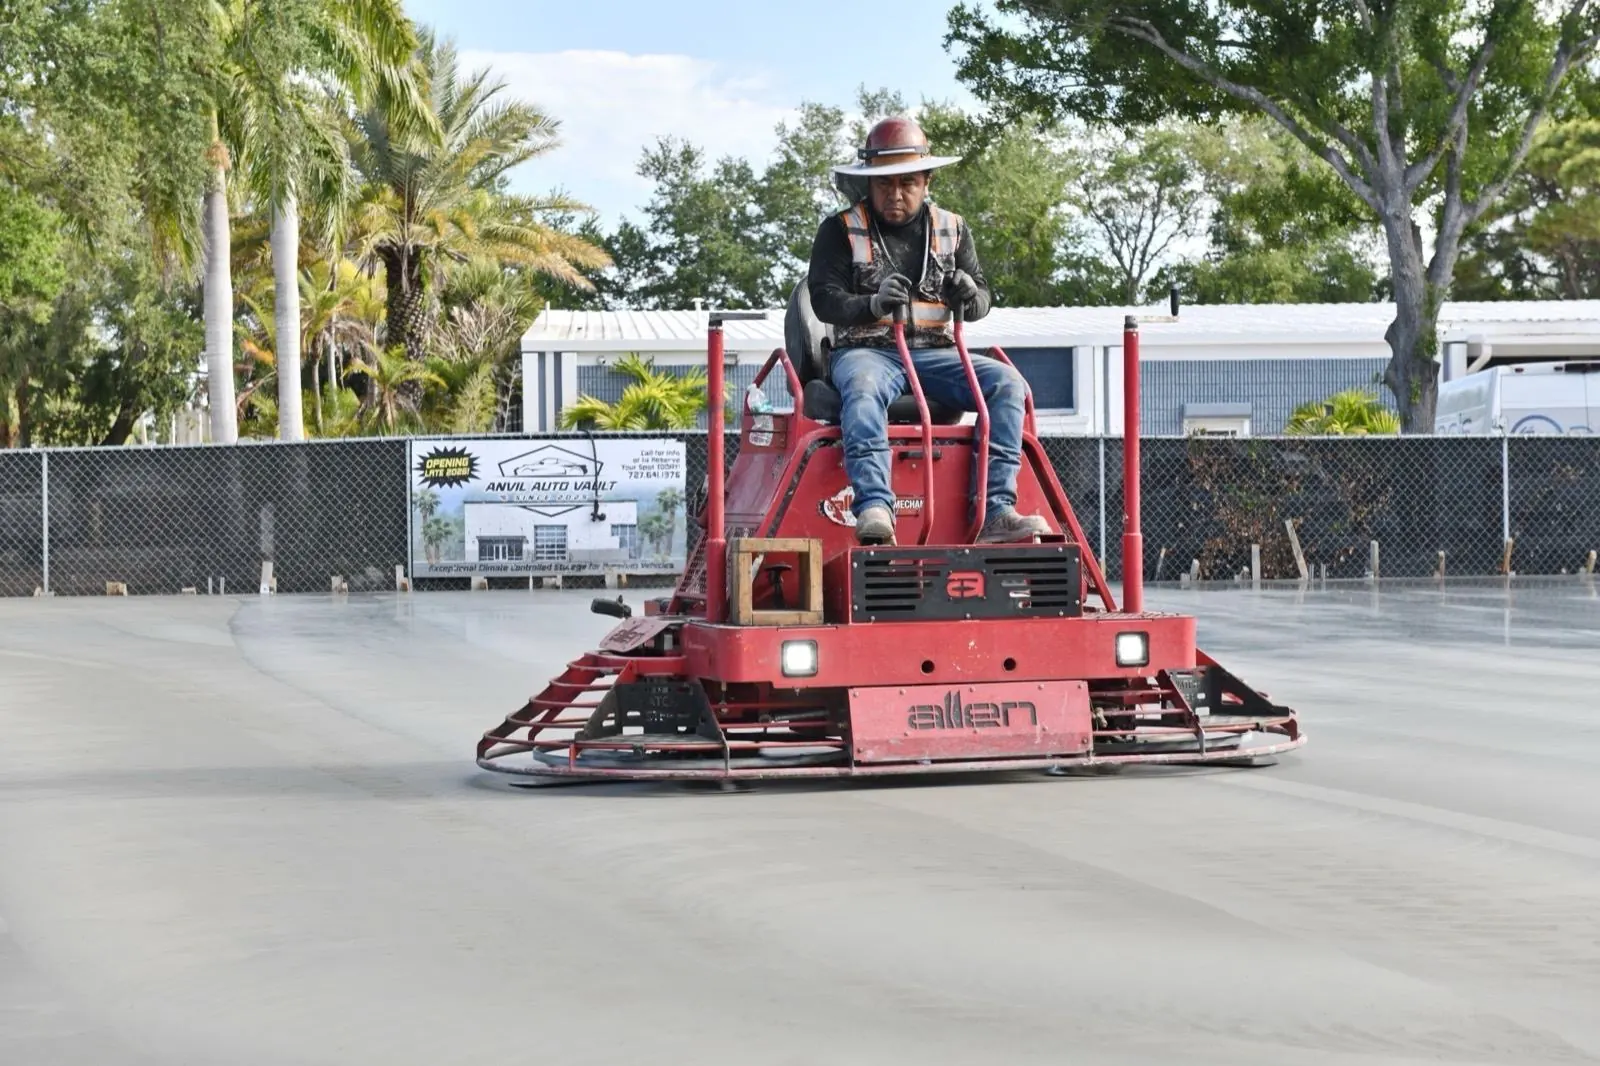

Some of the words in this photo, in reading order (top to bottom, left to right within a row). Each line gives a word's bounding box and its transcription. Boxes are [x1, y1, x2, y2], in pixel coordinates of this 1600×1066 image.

[426, 457, 469, 469] OPENING
[425, 468, 445, 477] LATE
[485, 481, 526, 492] ANVIL
[531, 481, 570, 492] AUTO
[574, 481, 618, 491] VAULT
[511, 563, 552, 572] Controlled
[907, 690, 1038, 730] allen
